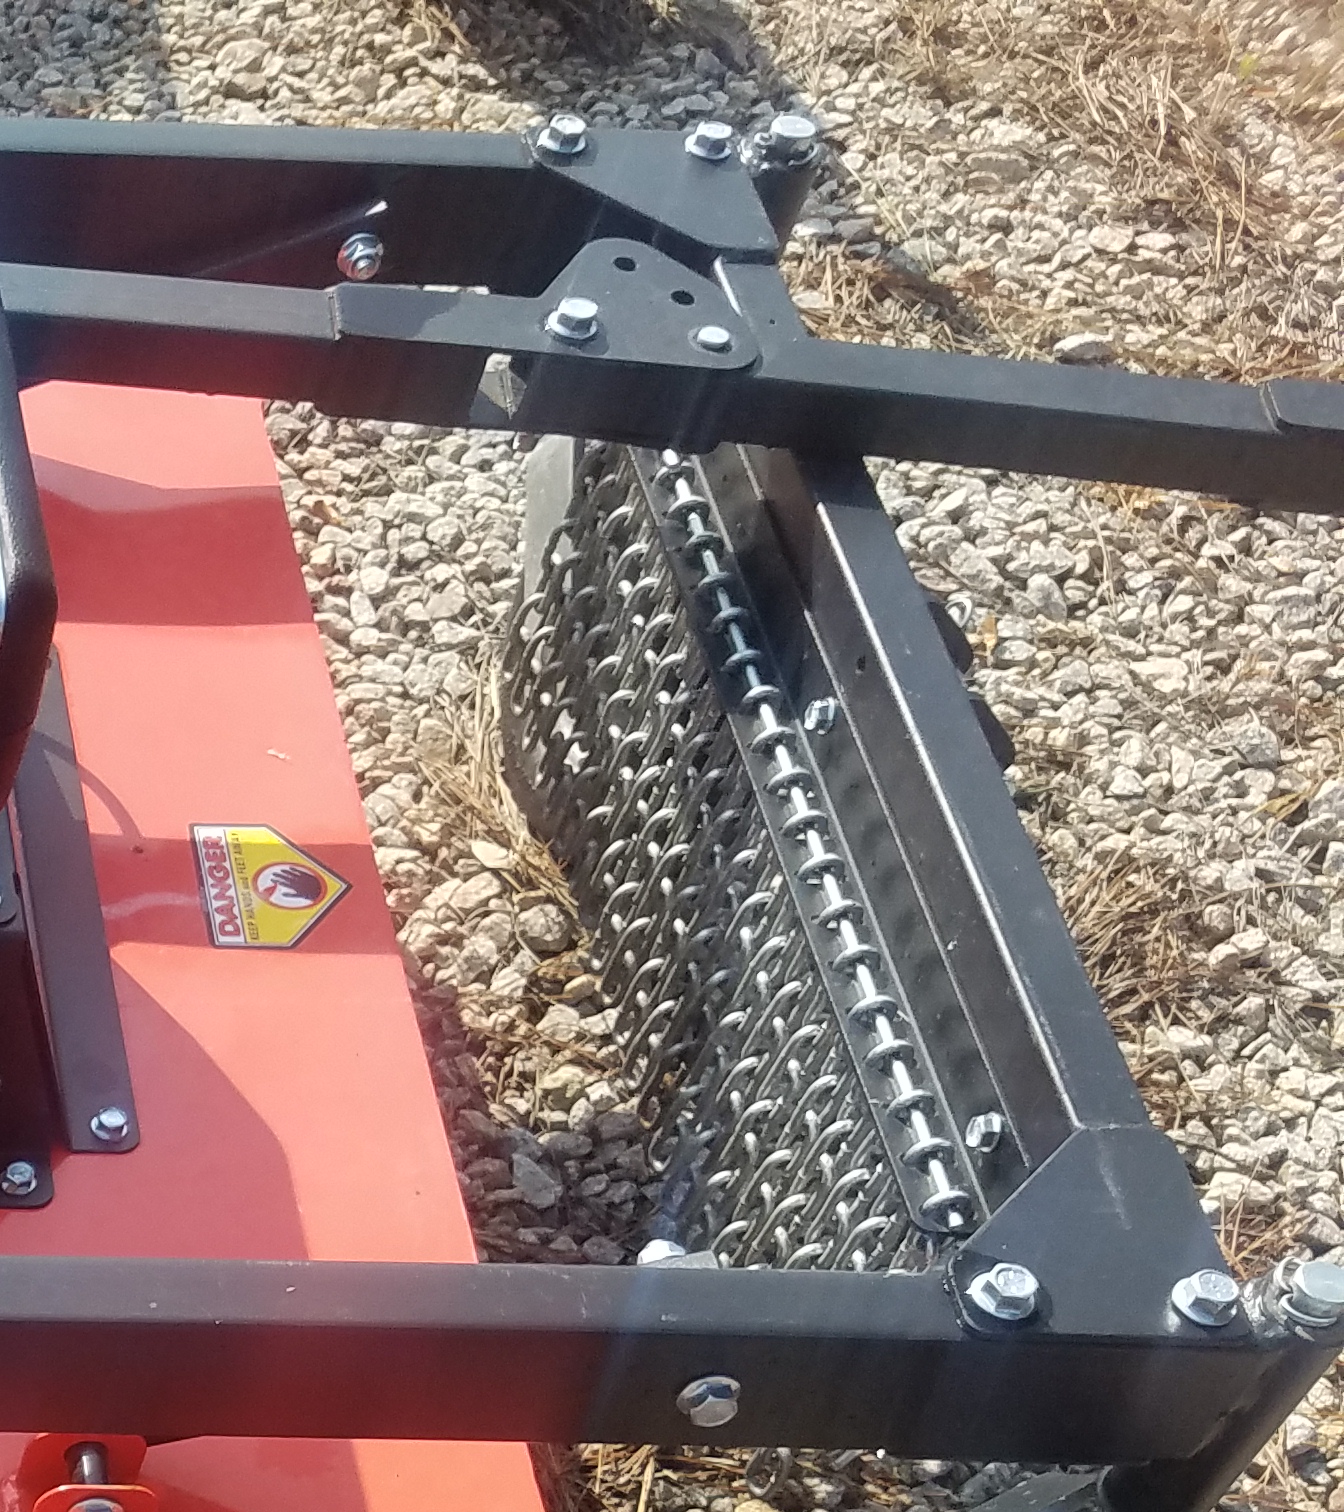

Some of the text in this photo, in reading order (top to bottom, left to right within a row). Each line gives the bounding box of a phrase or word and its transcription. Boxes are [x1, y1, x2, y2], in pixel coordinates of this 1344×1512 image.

[235, 857, 246, 874] FEET
[202, 836, 241, 936] DANGER
[241, 891, 255, 920] HANDS
[248, 921, 259, 940] KEEP
